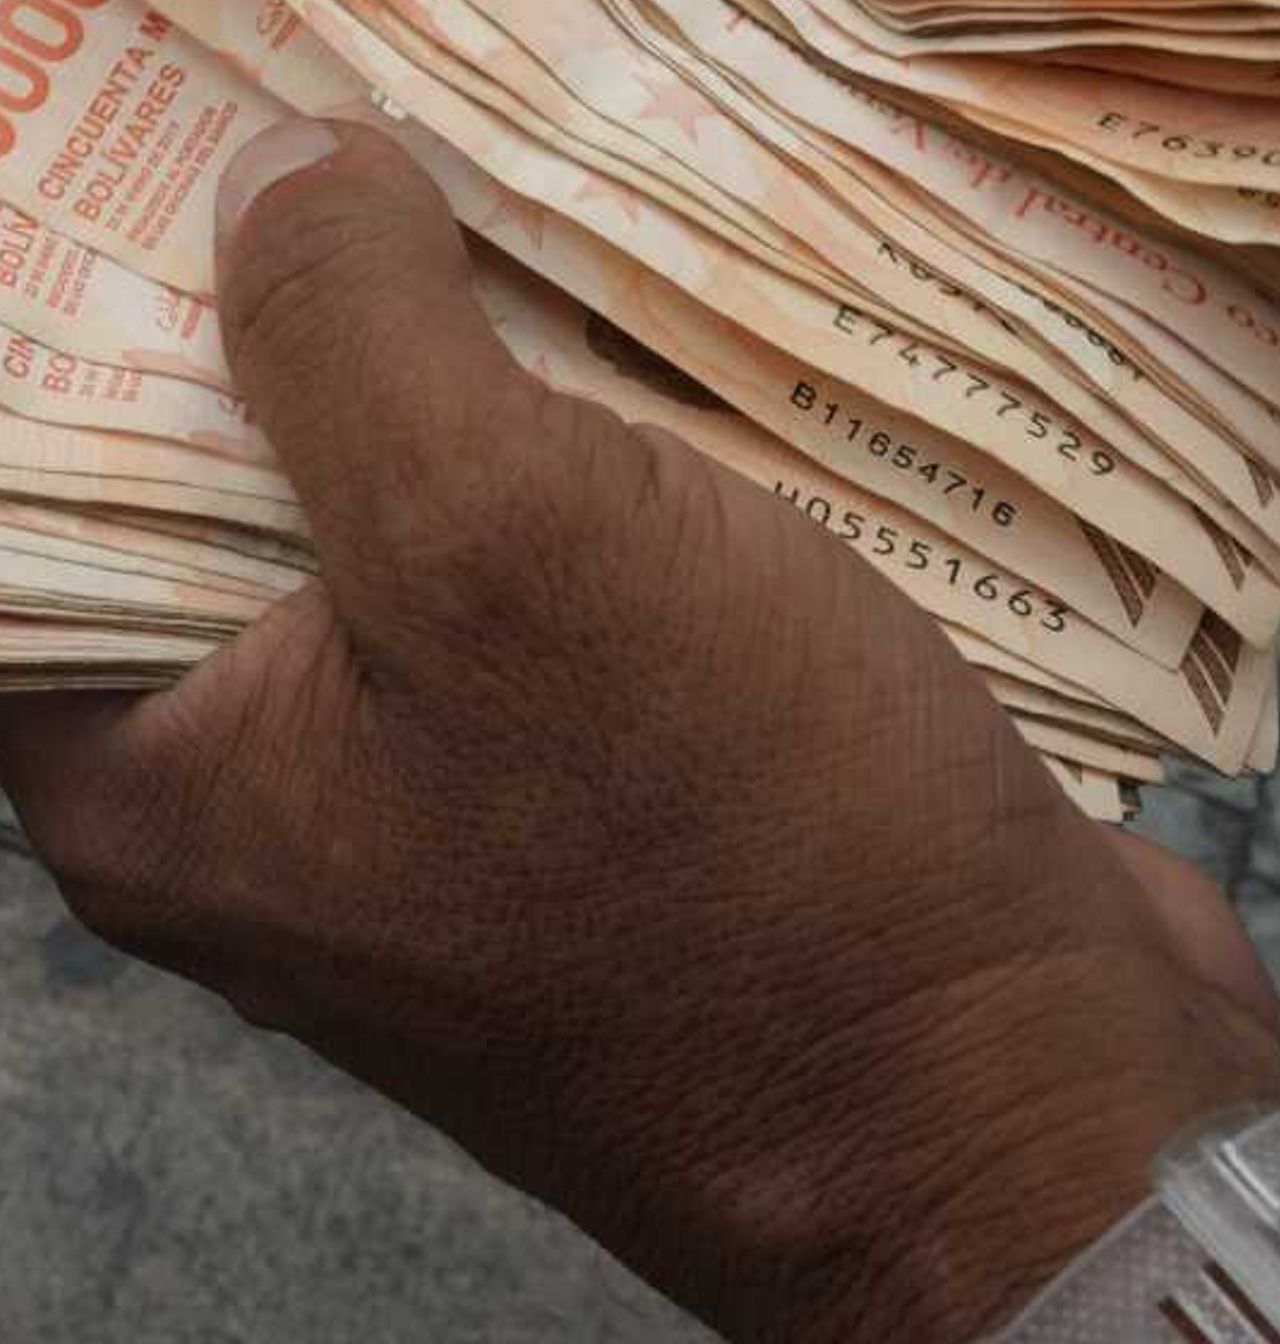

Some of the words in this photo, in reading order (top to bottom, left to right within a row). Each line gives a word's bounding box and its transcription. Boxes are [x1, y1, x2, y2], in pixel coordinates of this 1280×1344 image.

[38, 47, 155, 200] CINCUENTA
[73, 62, 186, 221] BOLÍVARES
[789, 381, 1018, 527] B11654716
[832, 303, 1117, 476] E74777529
